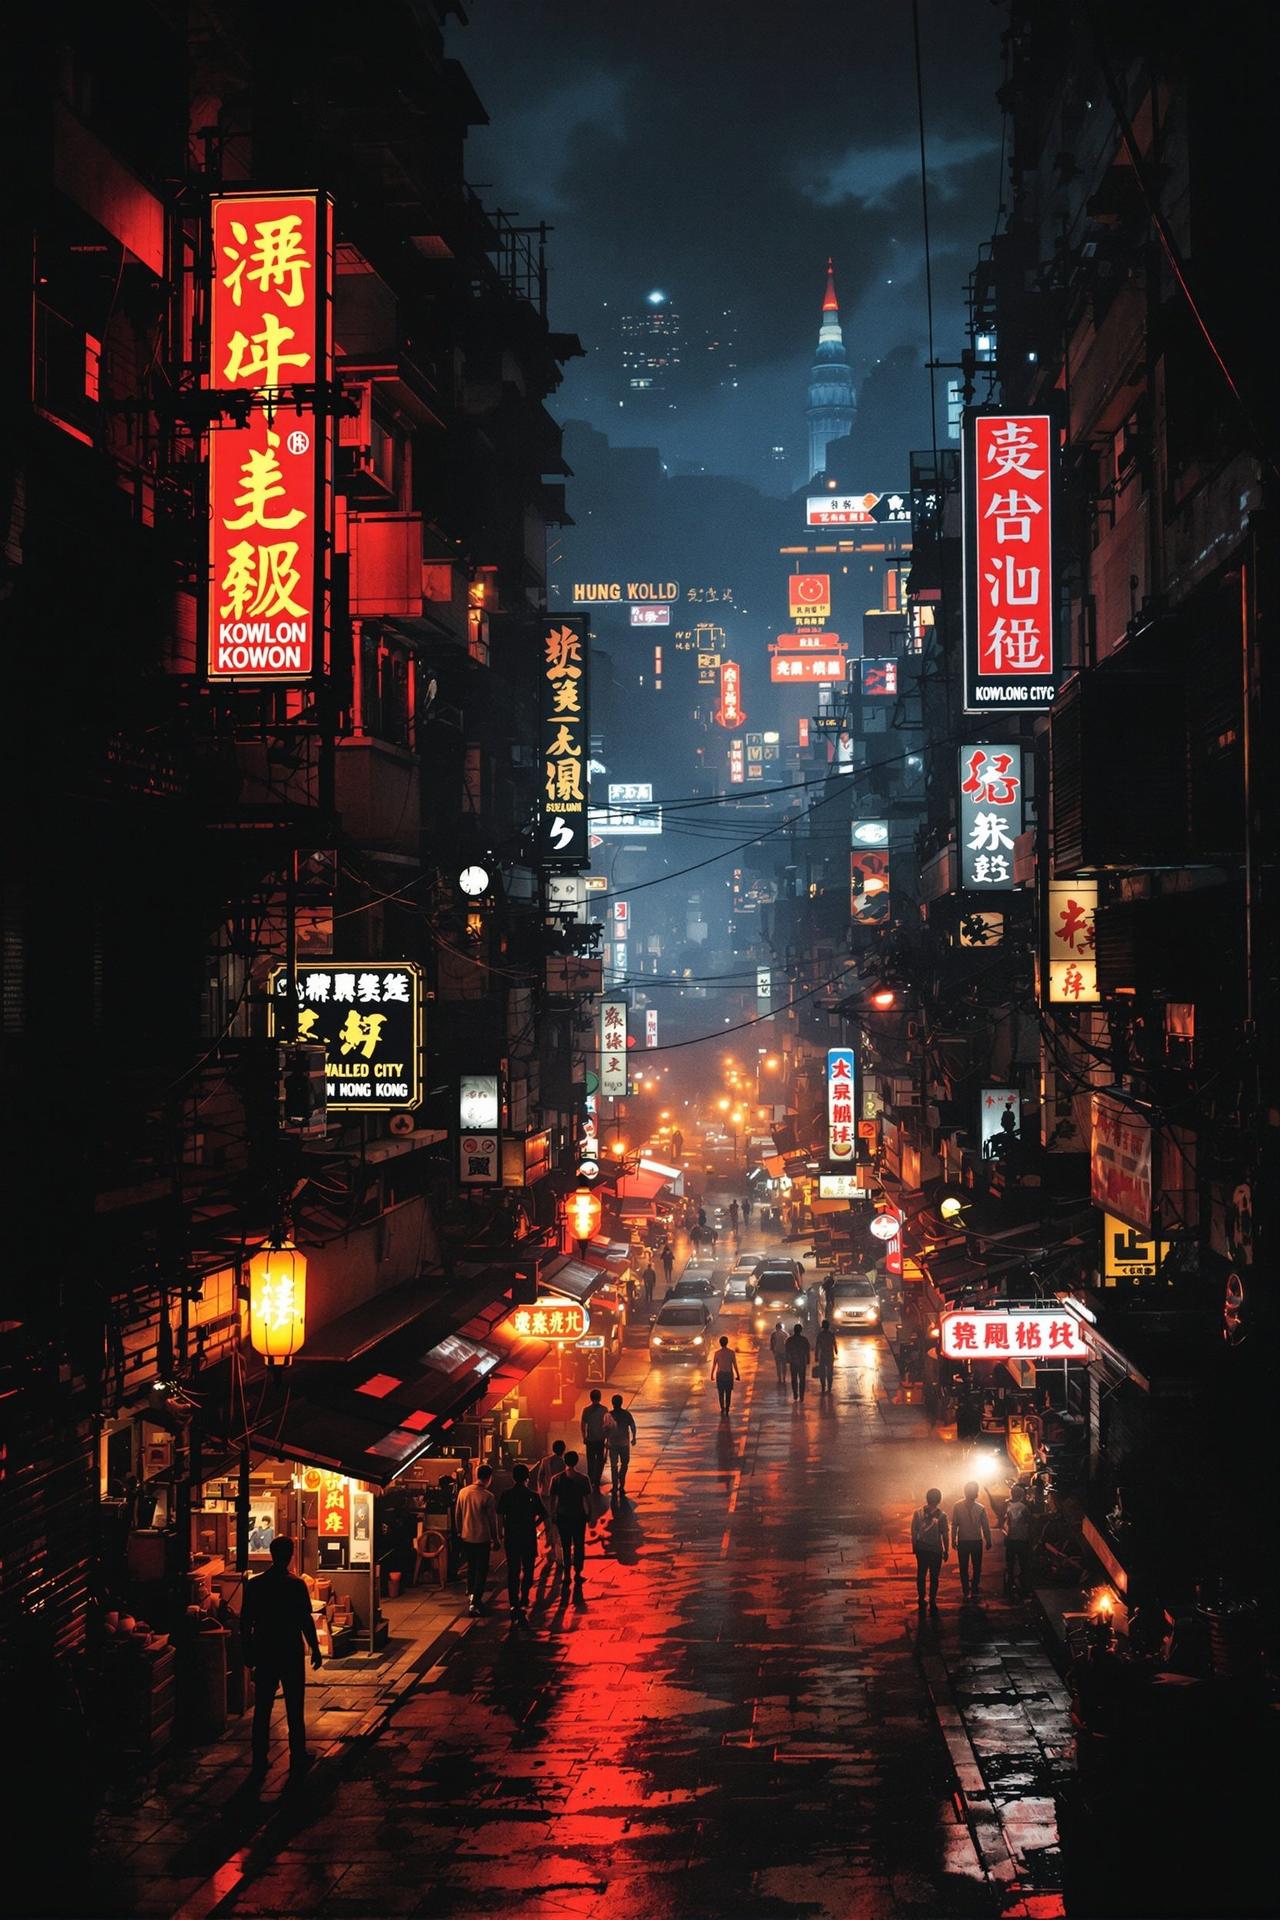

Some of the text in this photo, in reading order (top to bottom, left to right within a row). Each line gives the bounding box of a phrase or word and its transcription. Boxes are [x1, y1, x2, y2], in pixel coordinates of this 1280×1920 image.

[574, 584, 621, 600] HUNG
[627, 583, 677, 600] KOLLD
[219, 622, 306, 644] KOWLON
[218, 646, 301, 669] KOWON
[976, 687, 1028, 701] KOWLONG
[374, 1063, 404, 1078] CITY
[376, 1083, 409, 1098] KONG
